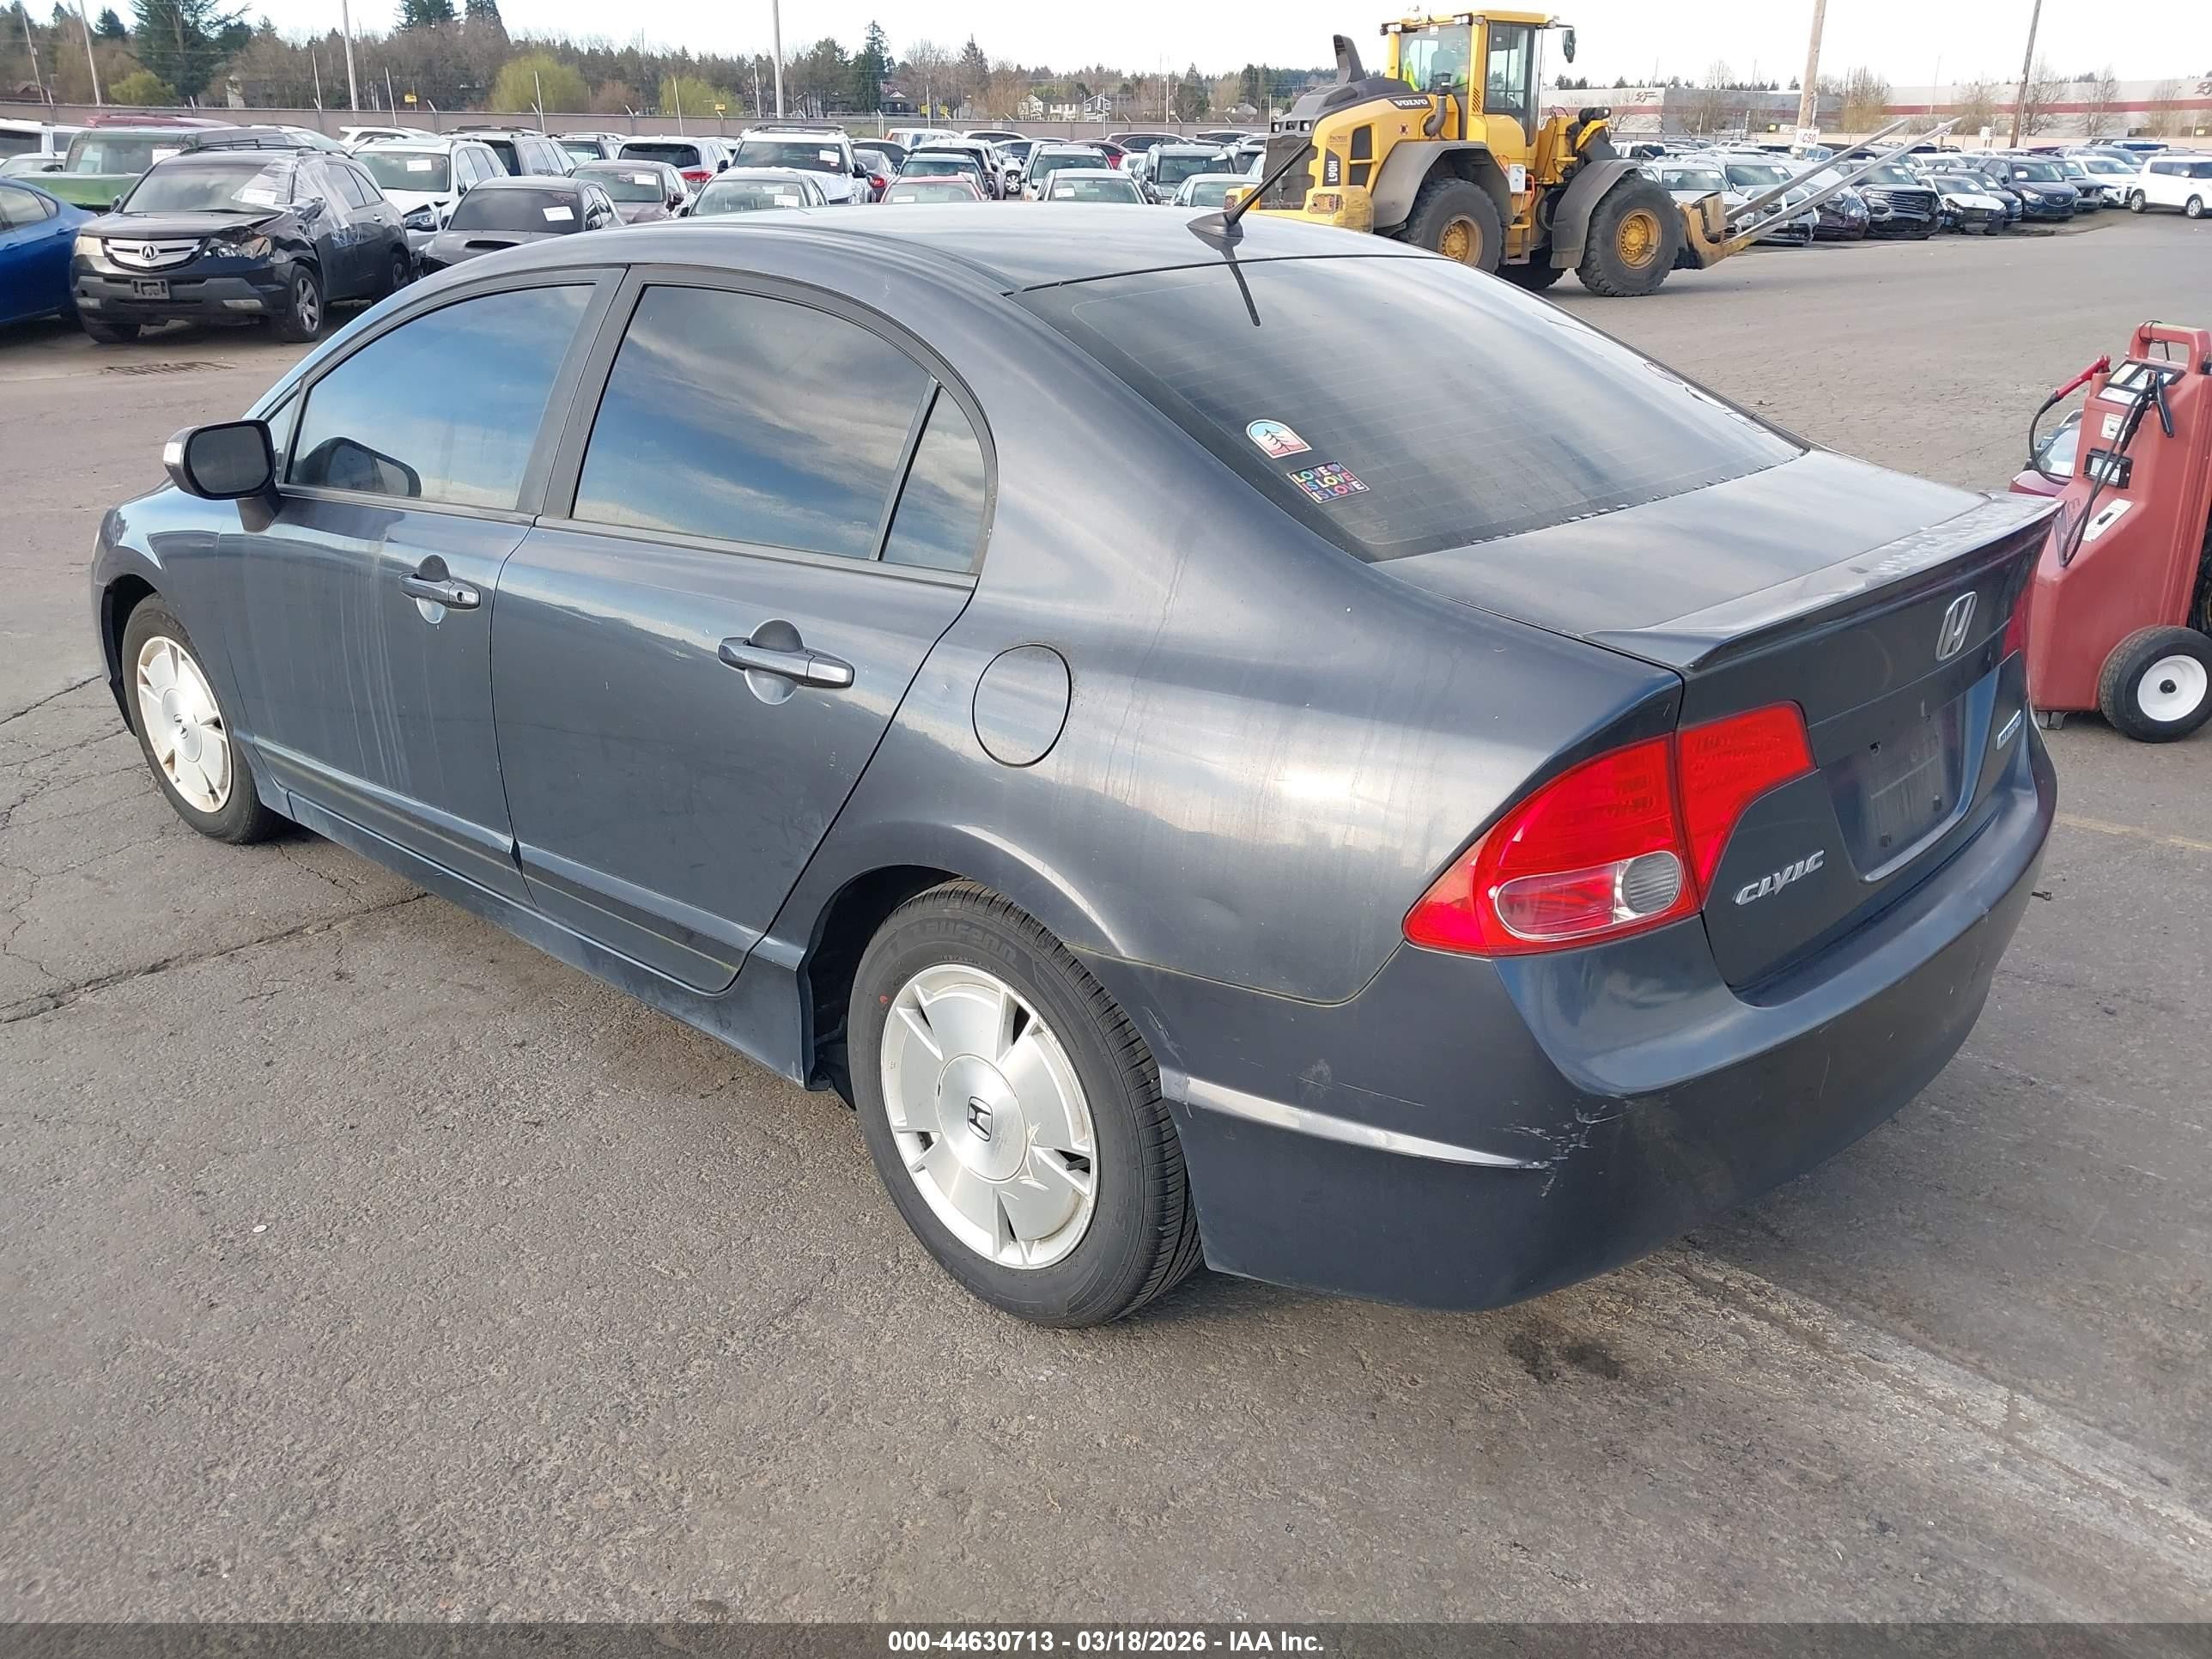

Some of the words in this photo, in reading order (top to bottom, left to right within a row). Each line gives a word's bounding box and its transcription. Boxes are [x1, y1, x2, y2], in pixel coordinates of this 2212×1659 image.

[1394, 98, 1428, 106] VOLVO
[1328, 161, 1338, 182] L90H
[1292, 465, 1332, 483] LOVE
[1302, 480, 1320, 492] IS
[1319, 471, 1354, 489] LOVE
[1310, 488, 1329, 501] IS
[1328, 480, 1365, 498] LOVE
[1735, 849, 1825, 906] CIVIC
